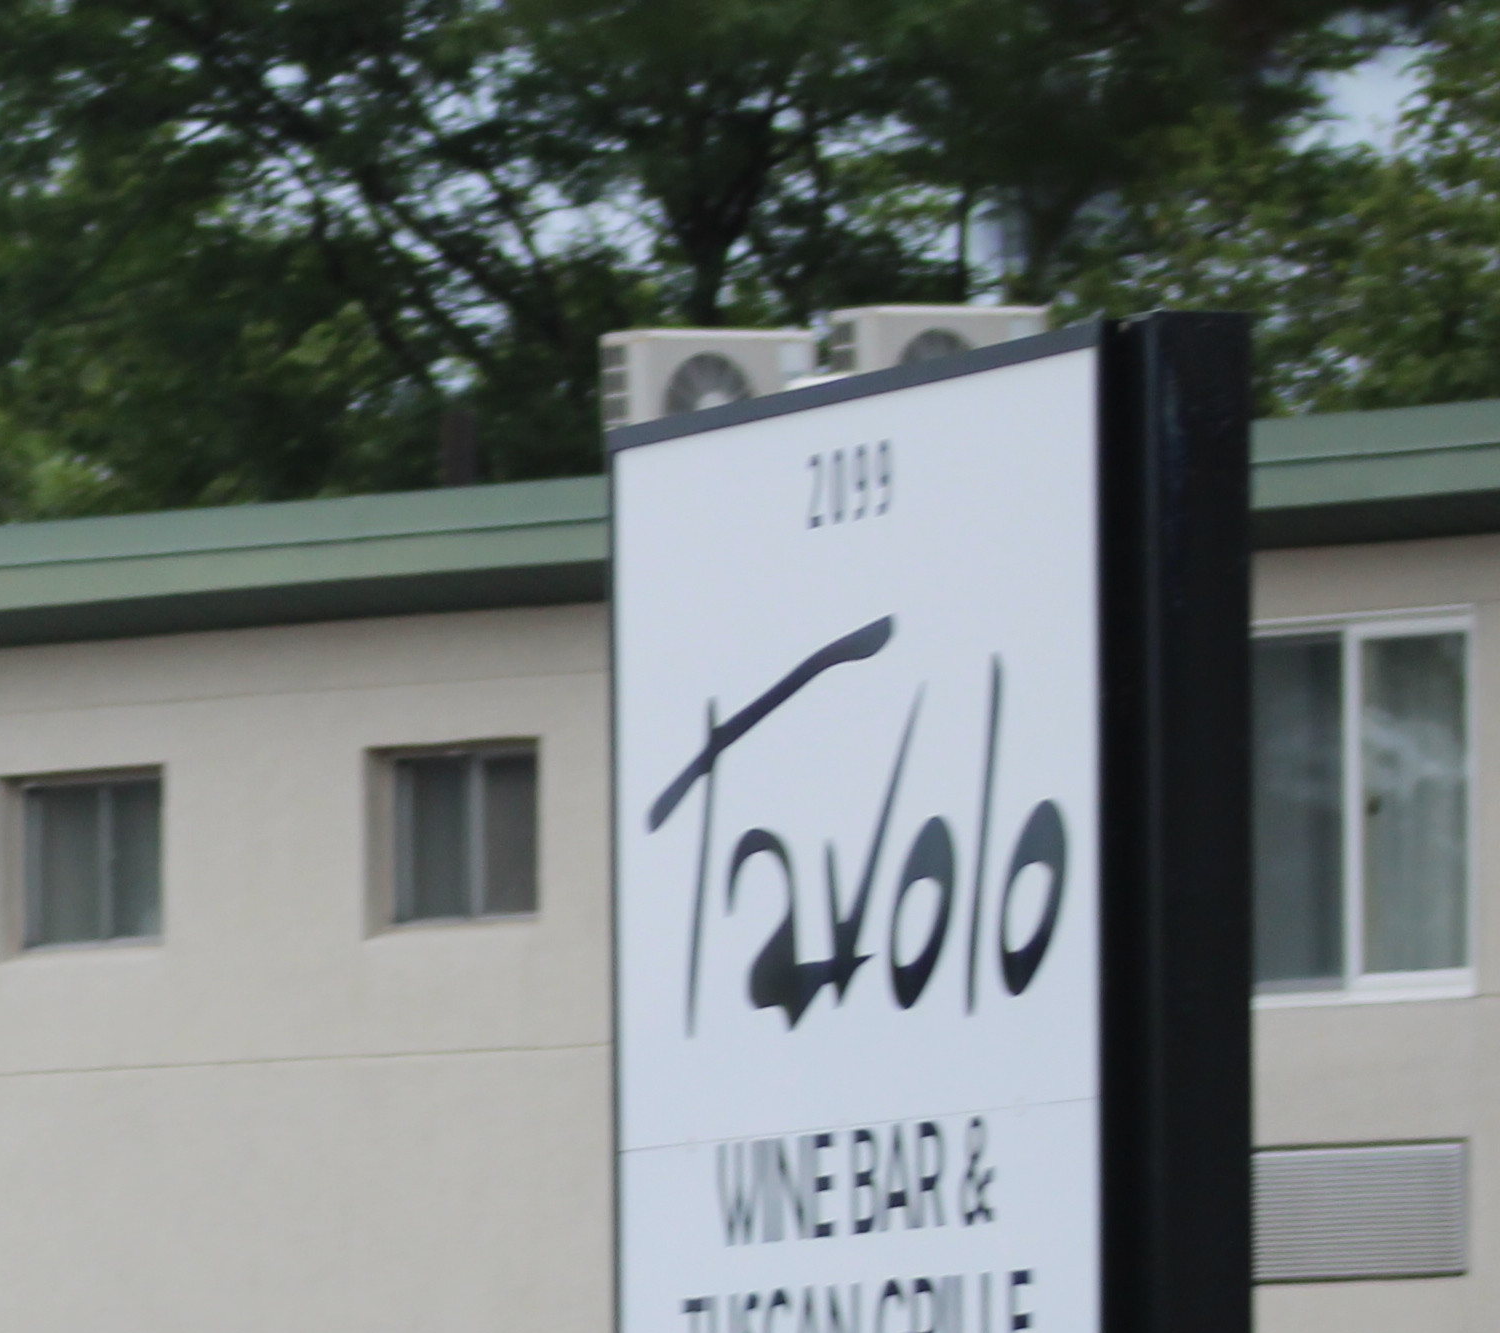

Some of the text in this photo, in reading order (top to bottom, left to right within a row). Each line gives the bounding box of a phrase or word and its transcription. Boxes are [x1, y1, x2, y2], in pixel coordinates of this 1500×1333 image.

[804, 439, 894, 530] 2099
[645, 613, 1068, 1040] Tavolo
[715, 1115, 996, 1247] WINE BAR &
